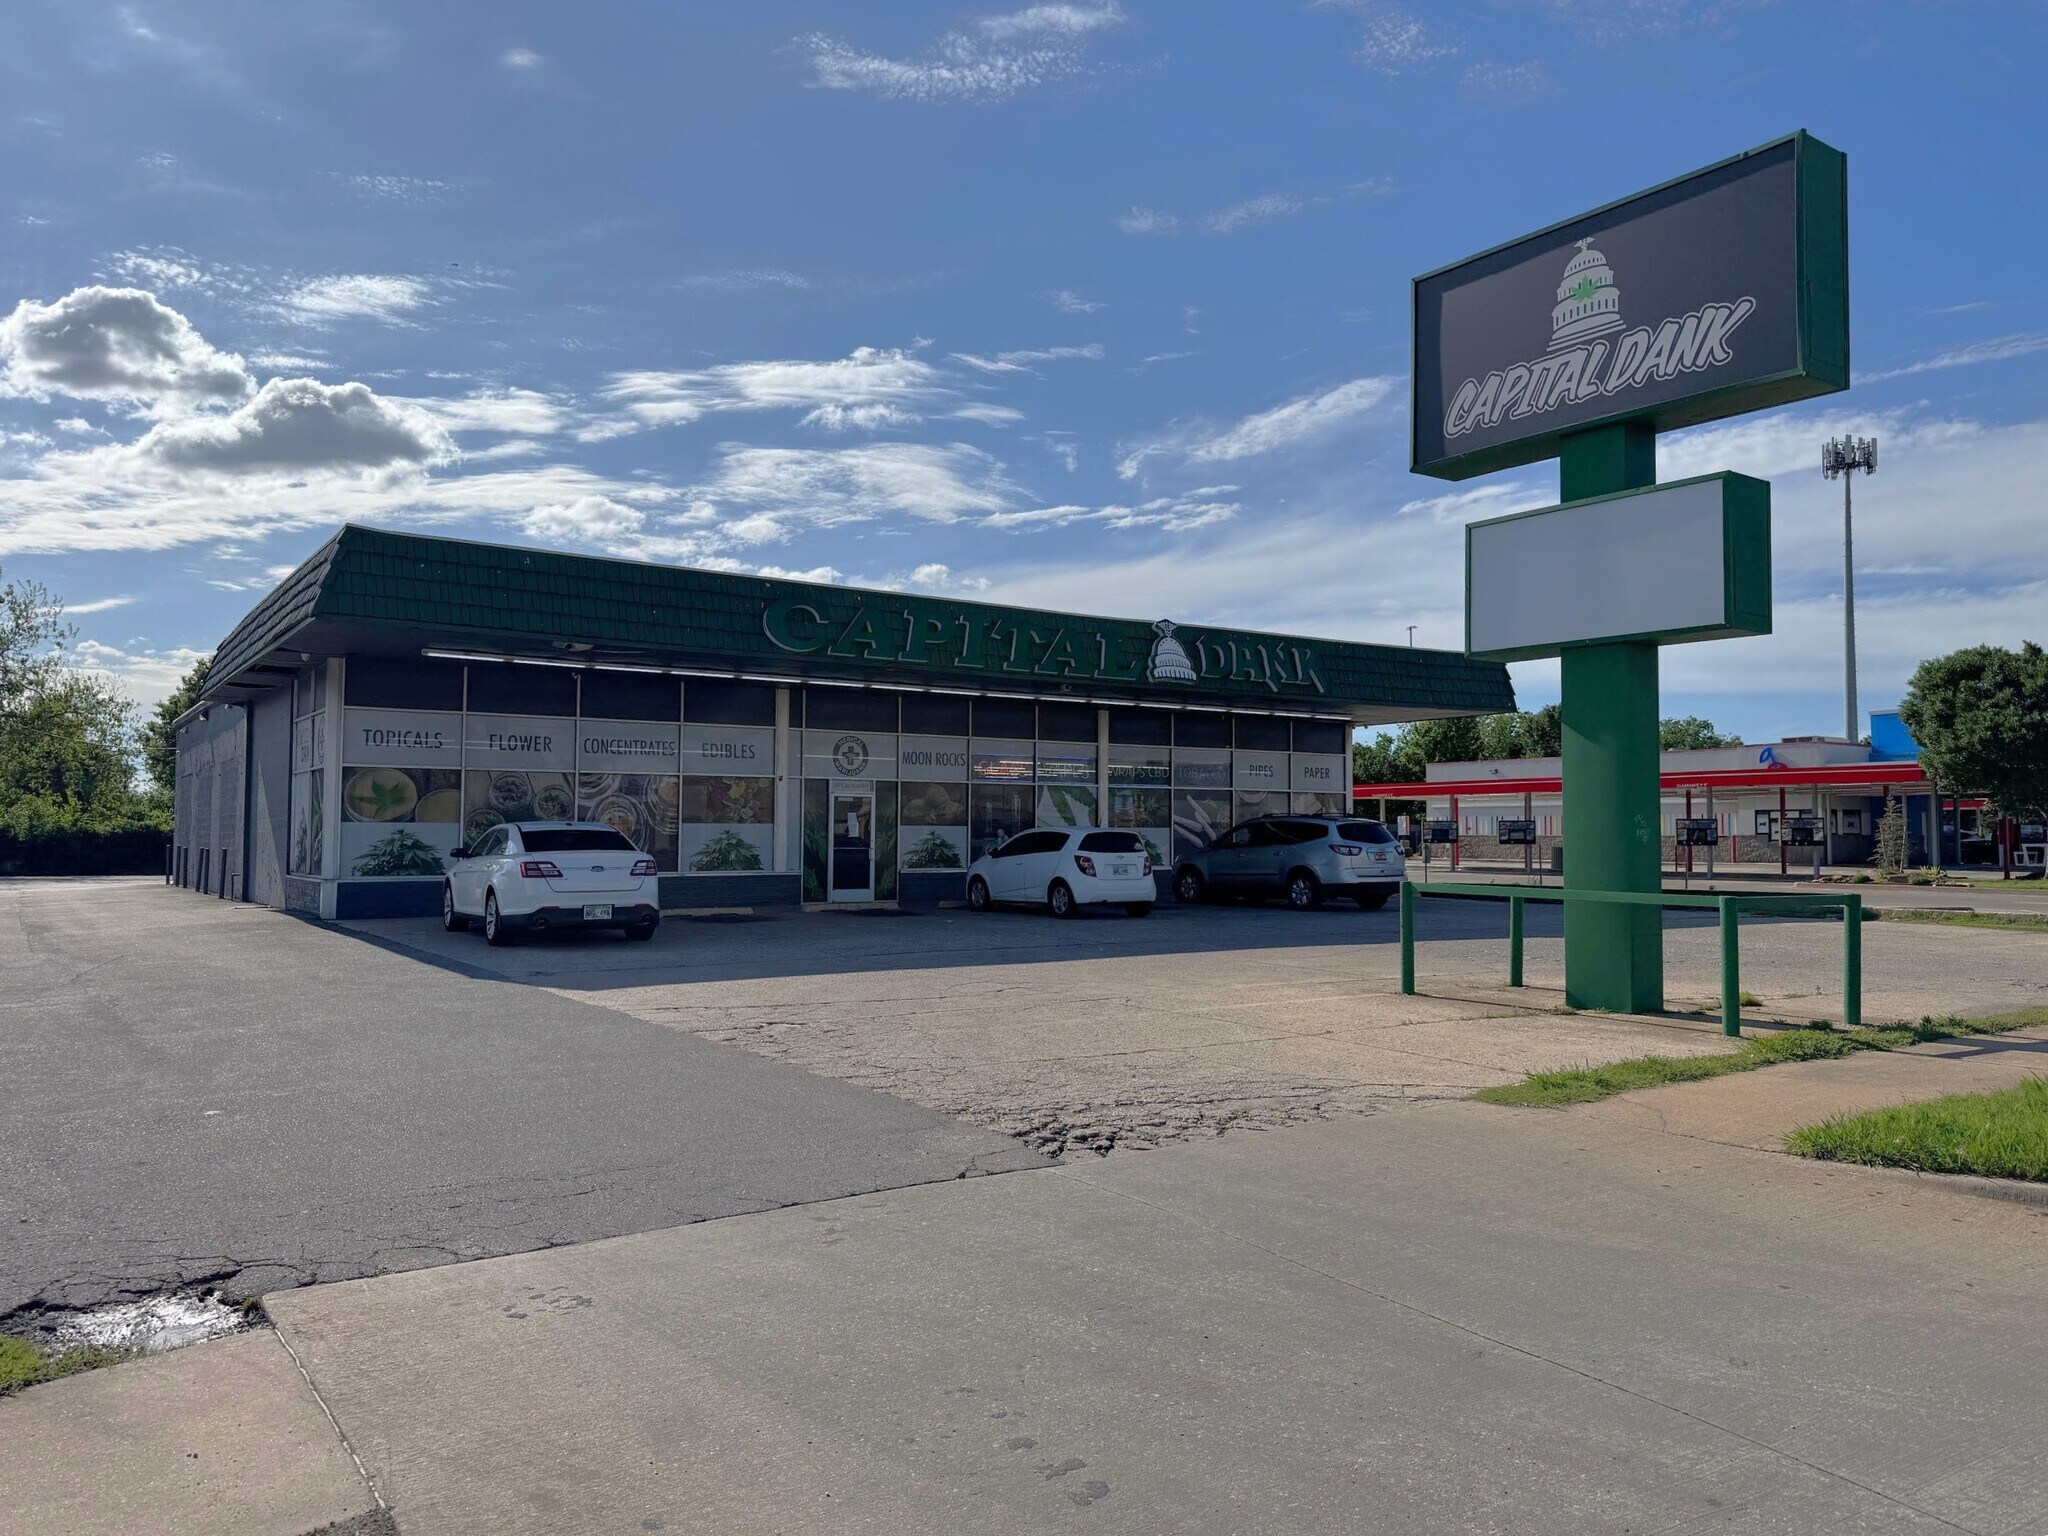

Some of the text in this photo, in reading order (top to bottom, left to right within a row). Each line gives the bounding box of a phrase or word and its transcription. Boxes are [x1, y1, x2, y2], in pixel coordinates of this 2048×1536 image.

[1444, 296, 1756, 438] CAPITAL DANK
[762, 601, 1326, 694] CAPITAL DANK
[362, 728, 443, 749] TOPICALS
[489, 734, 552, 752] FLOWER
[583, 738, 676, 756] CONCENTRATES
[837, 736, 864, 748] MEDICAL
[702, 742, 756, 760] EDIBLES
[902, 751, 966, 767] MOON ROCKS
[834, 760, 867, 776] MARIJUANA
[1147, 767, 1170, 778] CBD
[1249, 764, 1274, 778] PIPES
[1304, 766, 1331, 780] PAPER
